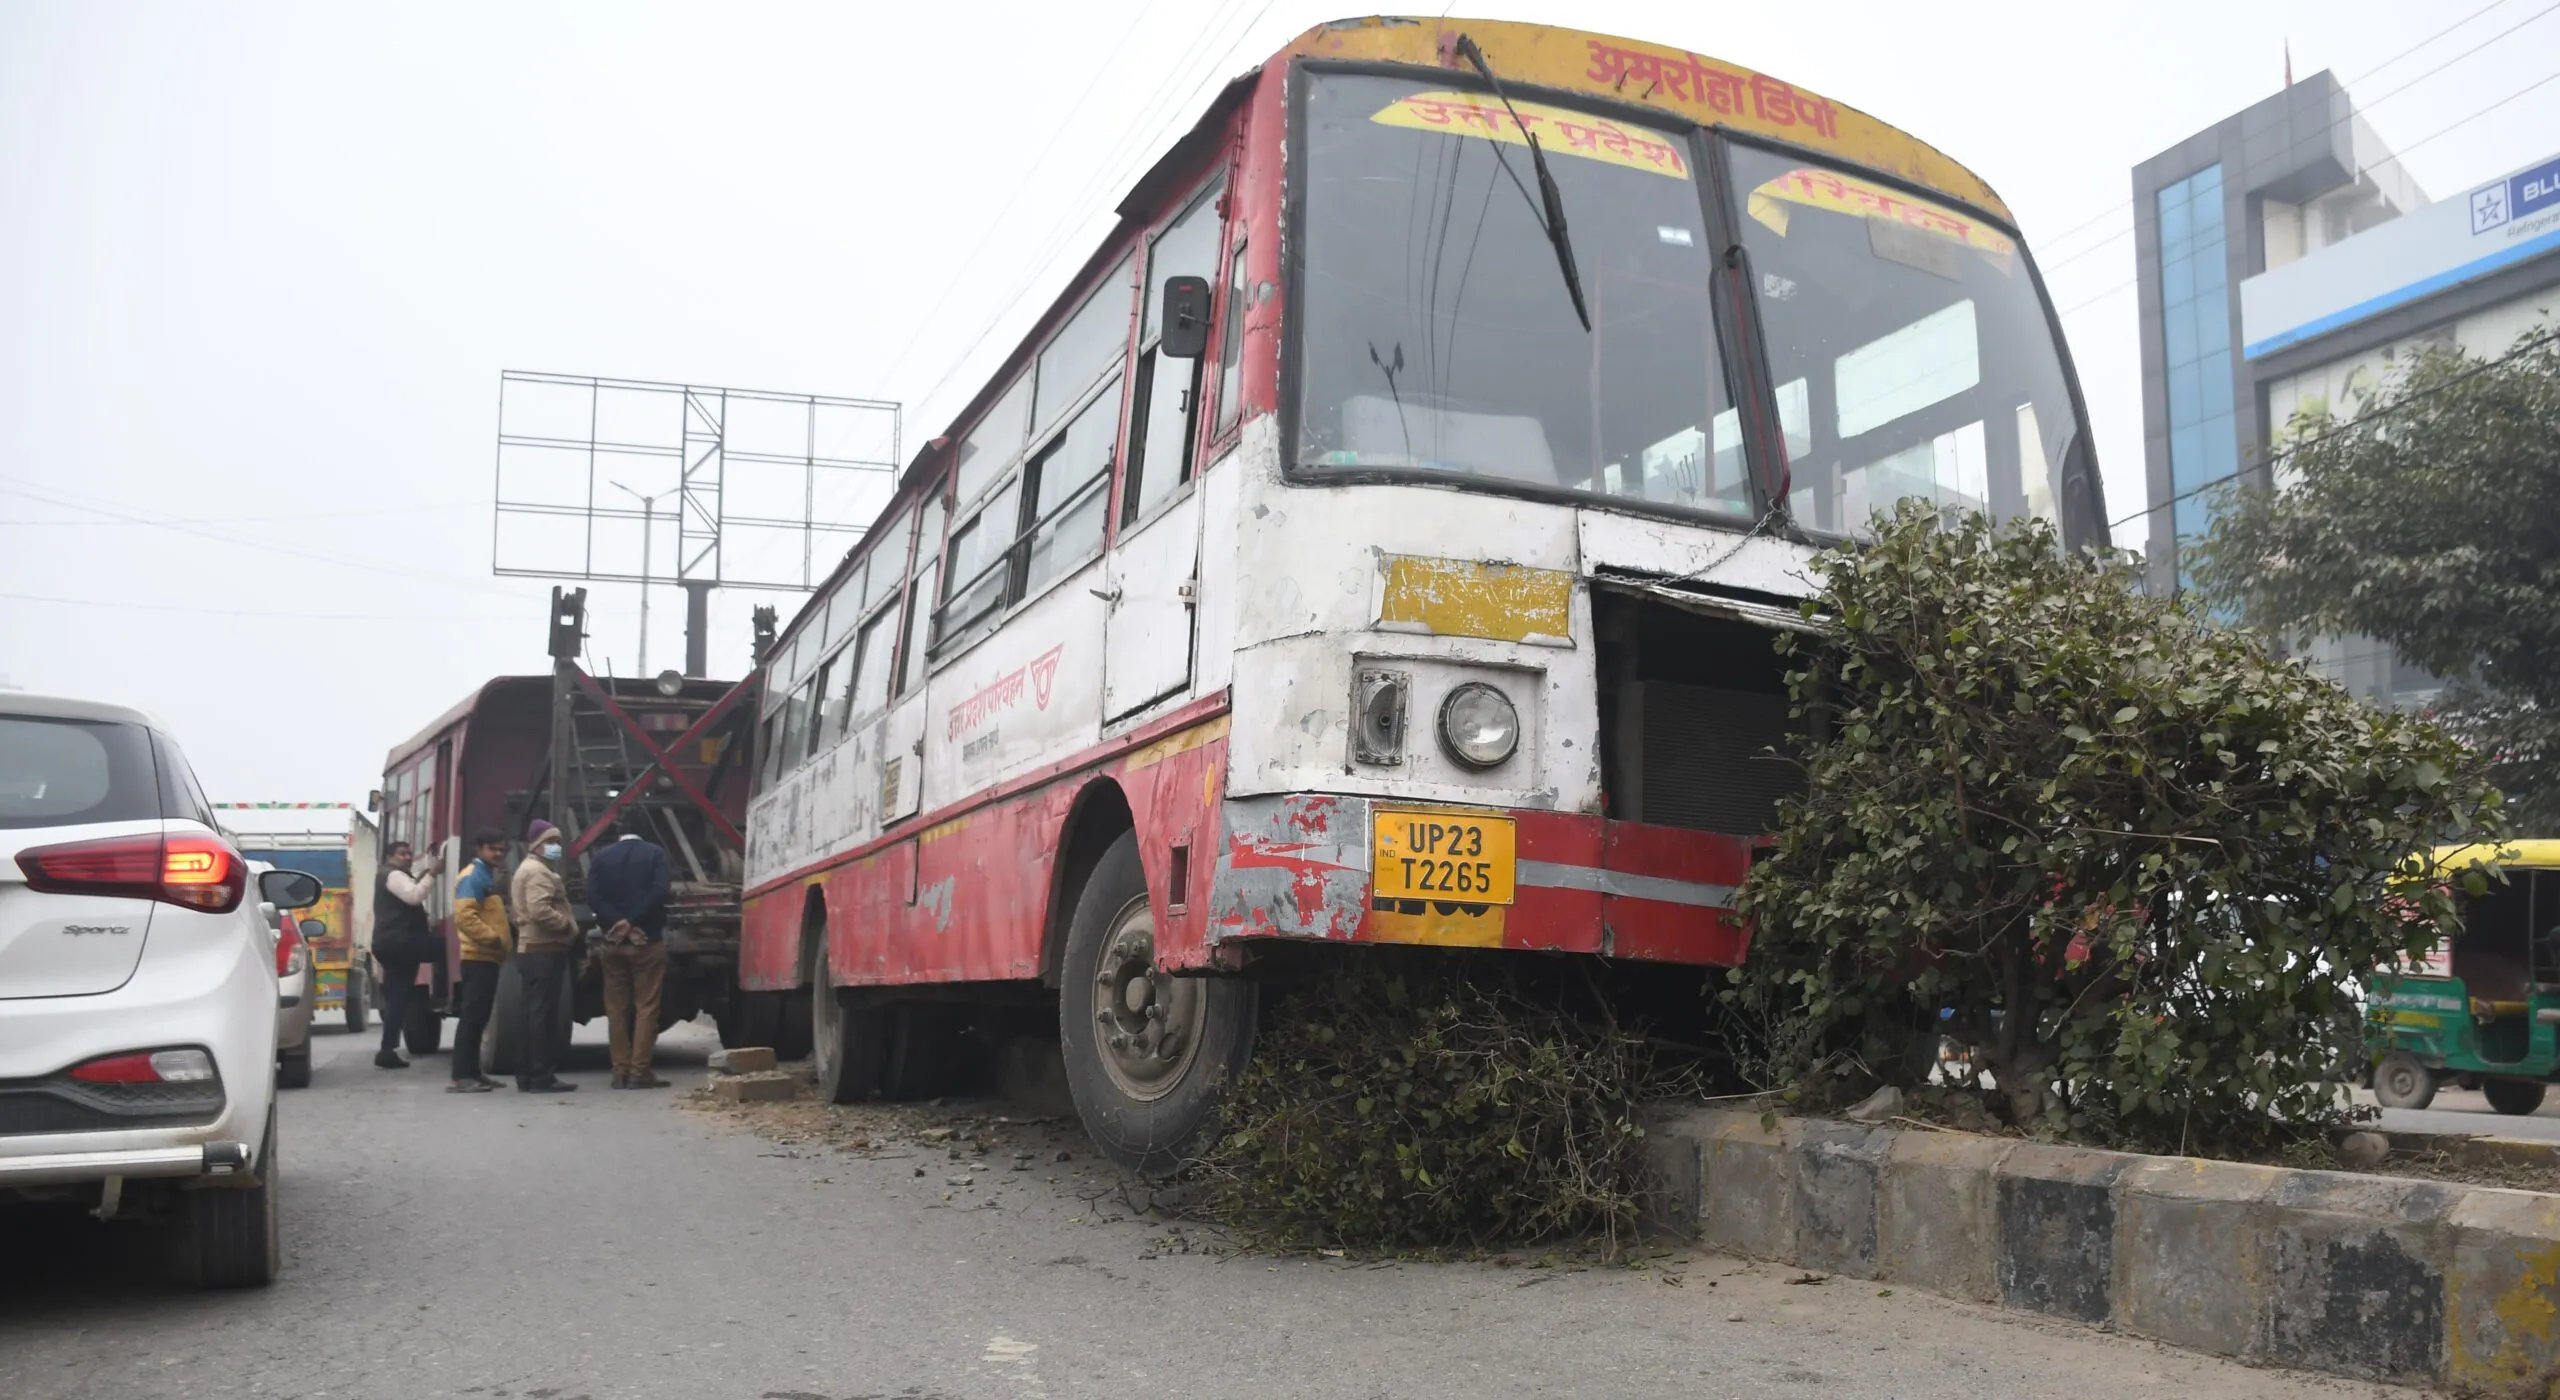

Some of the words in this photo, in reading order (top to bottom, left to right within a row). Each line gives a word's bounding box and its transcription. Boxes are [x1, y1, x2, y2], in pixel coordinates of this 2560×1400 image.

[1586, 40, 1745, 116] अमरोहा
[1554, 119, 1684, 173] प्रदेश
[1379, 848, 1396, 858] IND
[1409, 822, 1482, 857] UP23
[1400, 857, 1491, 893] T2265
[62, 924, 130, 937] Sportz
